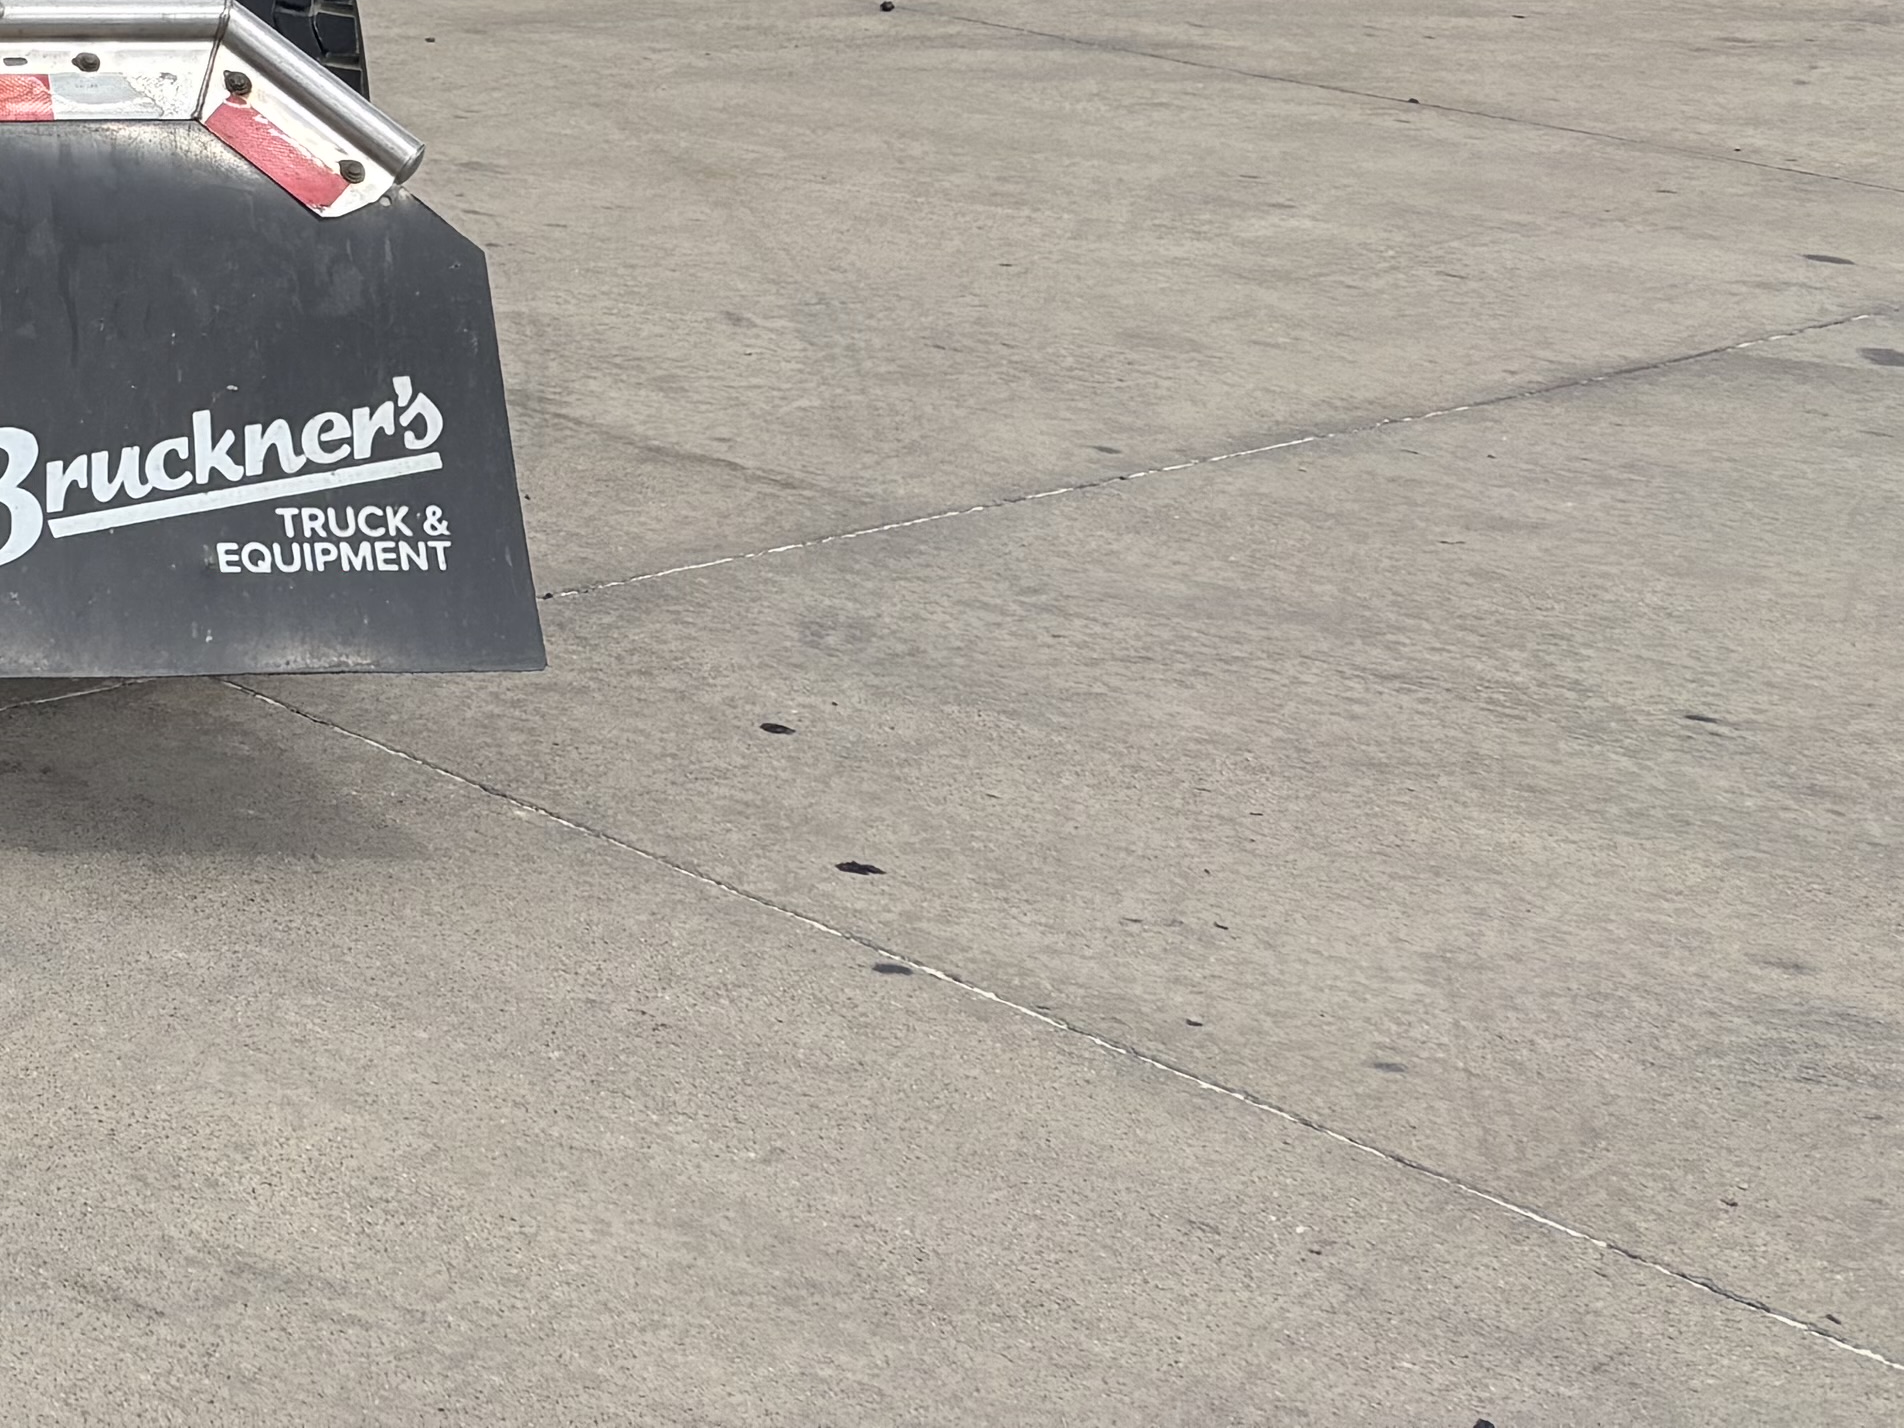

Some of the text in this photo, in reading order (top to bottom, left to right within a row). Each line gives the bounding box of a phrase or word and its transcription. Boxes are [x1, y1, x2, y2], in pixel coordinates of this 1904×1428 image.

[274, 504, 451, 539] TRUCK &
[216, 540, 452, 574] EQUIPMENT
